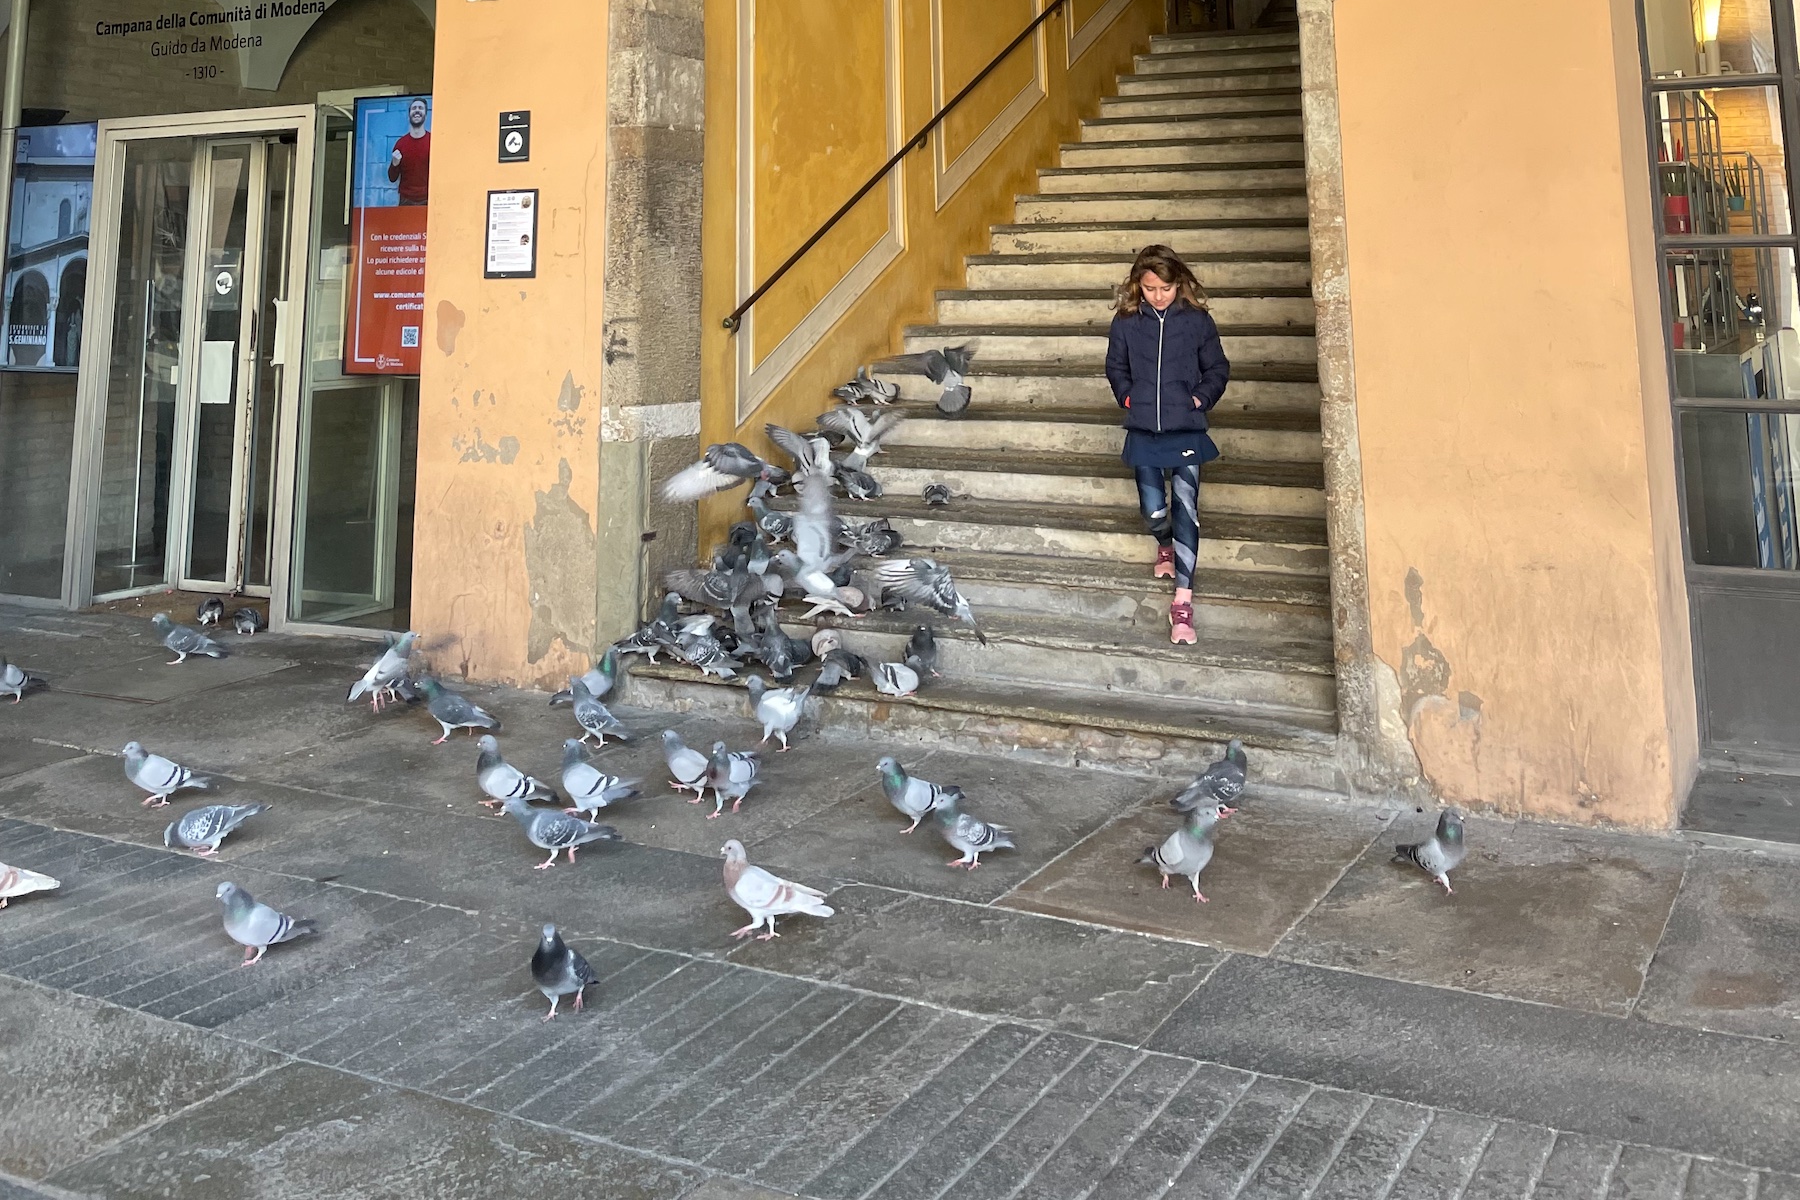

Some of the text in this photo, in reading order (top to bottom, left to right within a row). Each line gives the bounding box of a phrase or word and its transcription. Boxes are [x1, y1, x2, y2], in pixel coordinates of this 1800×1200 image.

[96, 0, 326, 37] Campana della Comunità di Modena
[151, 34, 262, 57] Guido da Modena
[193, 65, 217, 81] 1310
[375, 257, 388, 265] puoi
